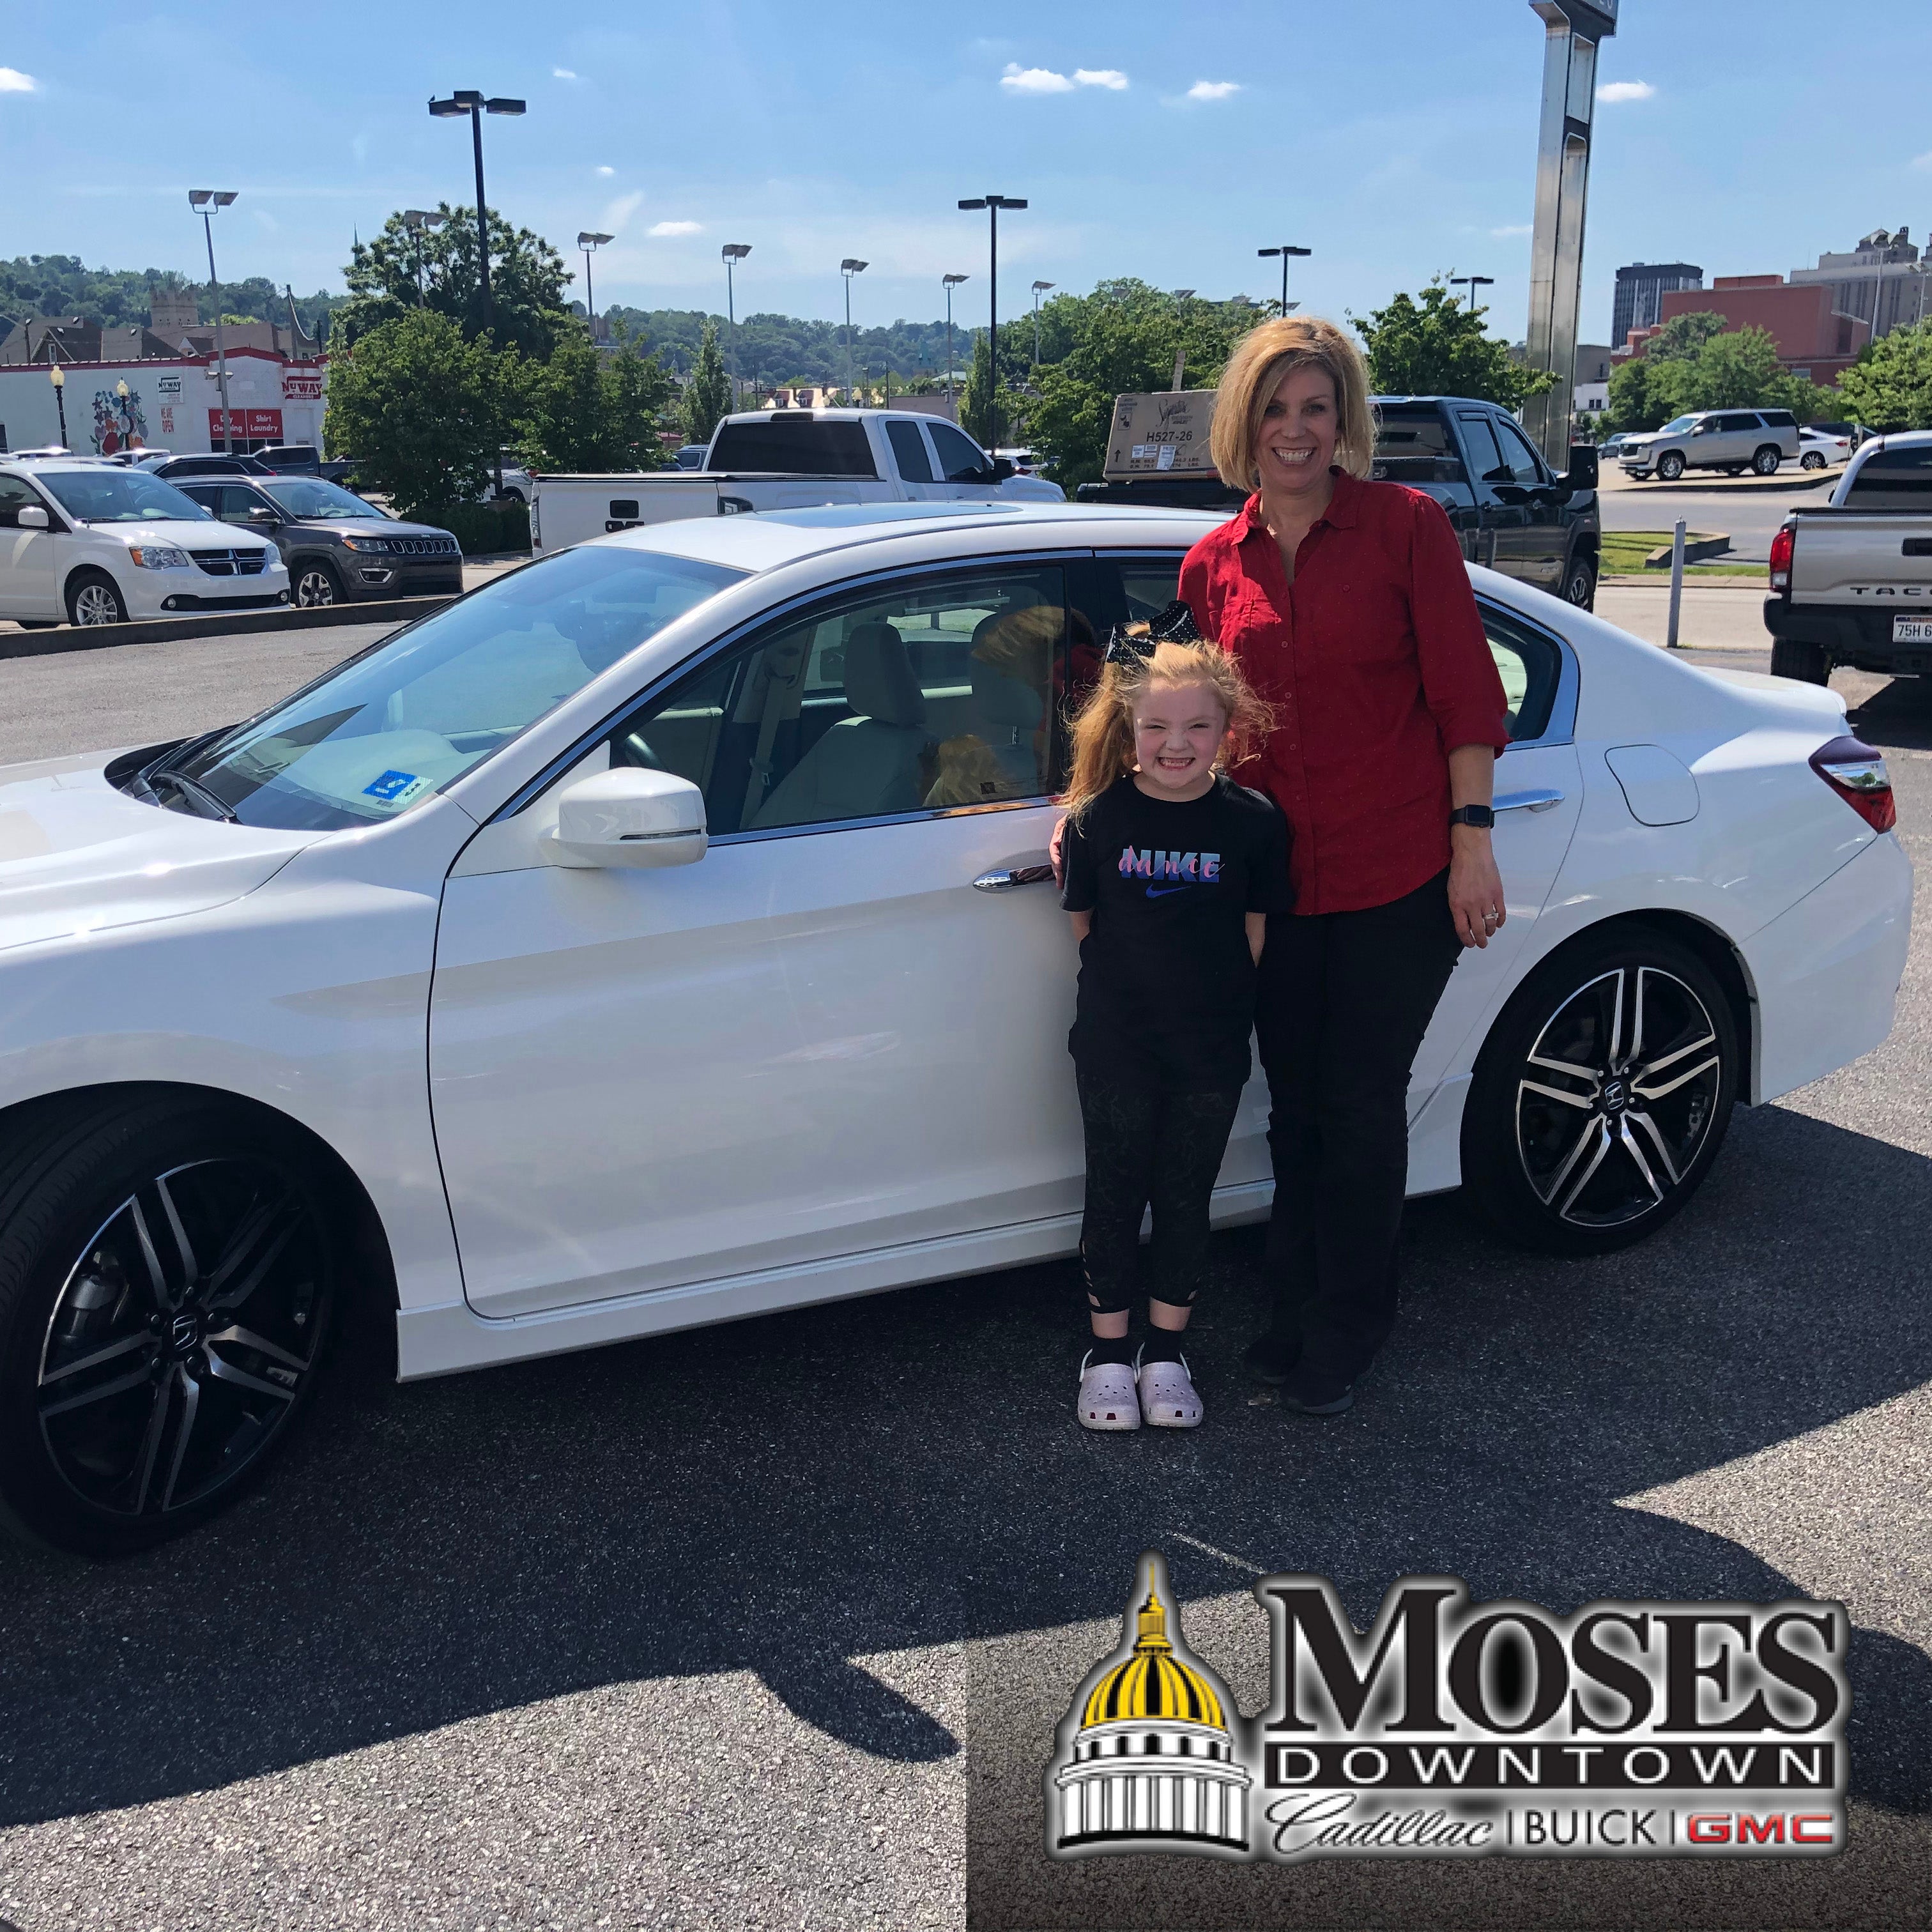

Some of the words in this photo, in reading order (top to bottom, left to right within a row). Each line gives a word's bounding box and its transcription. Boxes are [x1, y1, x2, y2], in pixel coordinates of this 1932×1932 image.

[220, 415, 233, 424] Dy
[250, 423, 278, 433] Laundry
[1146, 431, 1193, 442] H527-26
[1850, 587, 1932, 596] TAC
[1897, 625, 1920, 637] 75H
[1121, 848, 1220, 883] NIKE
